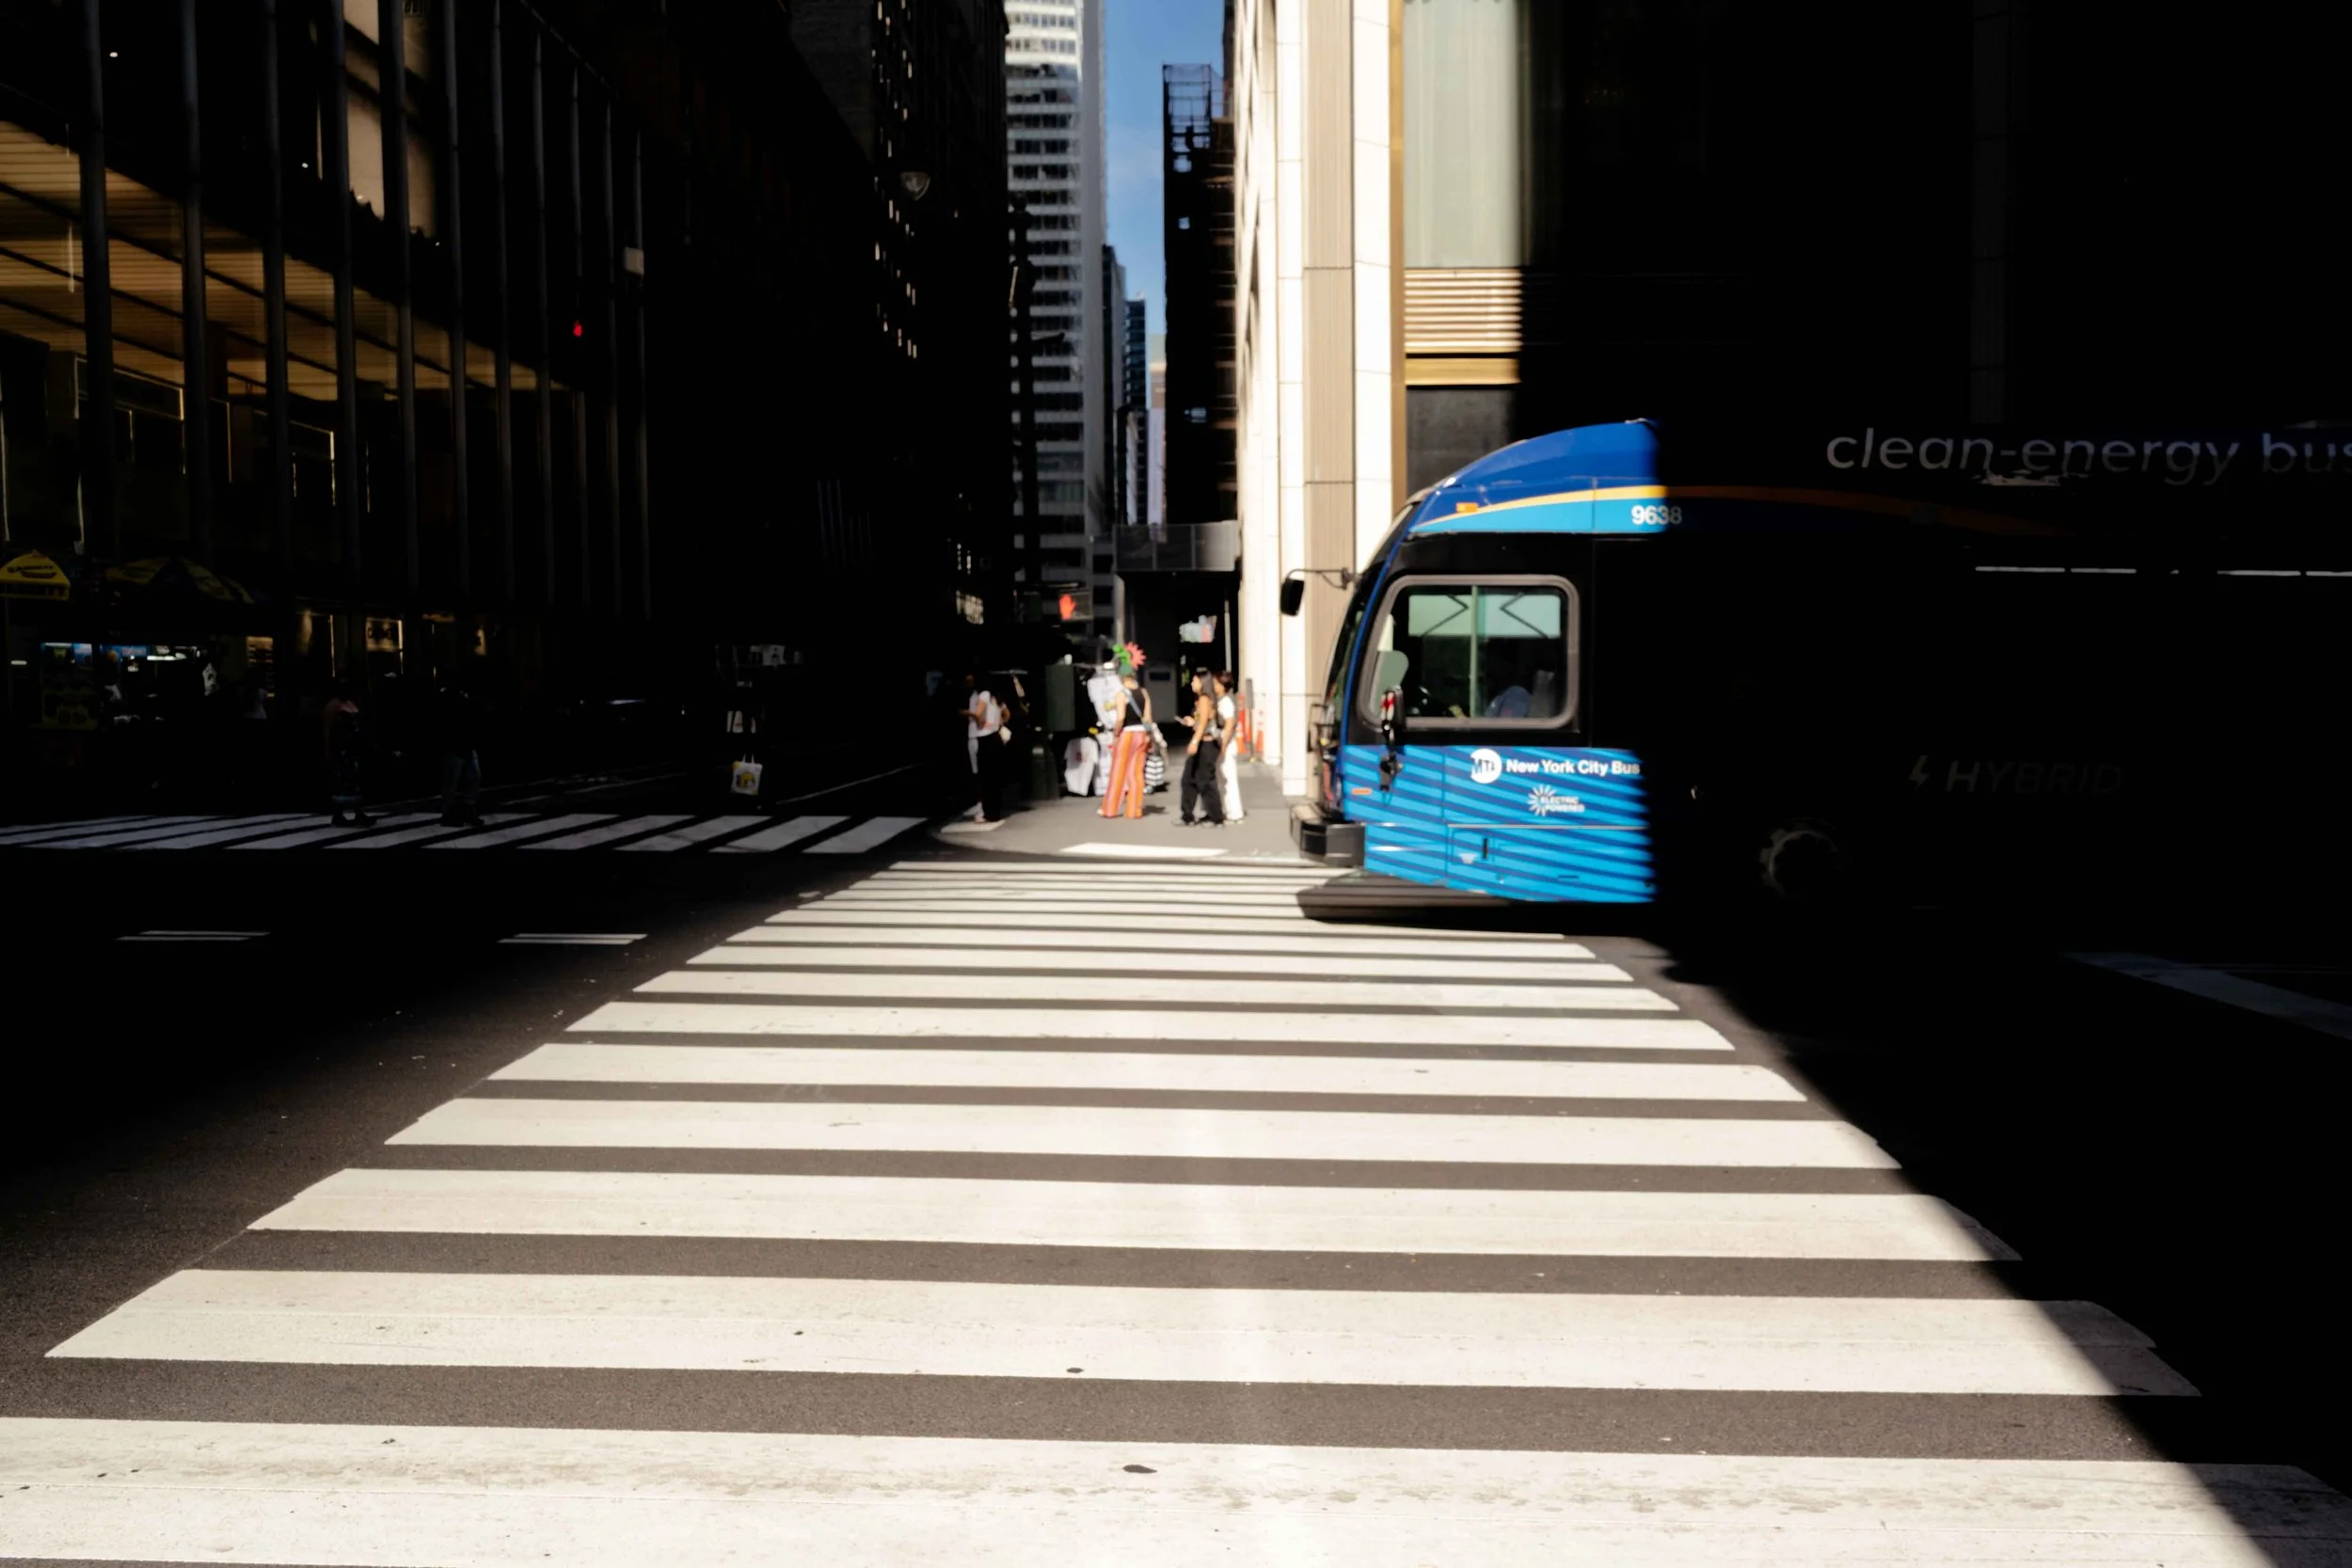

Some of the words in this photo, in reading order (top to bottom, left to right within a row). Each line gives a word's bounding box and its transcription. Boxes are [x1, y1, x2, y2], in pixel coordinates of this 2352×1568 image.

[1825, 426, 2240, 486] clean-energy
[1630, 504, 1683, 526] 9638
[1505, 759, 1539, 774] New
[1541, 759, 1575, 774] York
[1577, 759, 1609, 777] City
[1611, 760, 1641, 775] Bus
[1945, 760, 2124, 794] HYBRID
